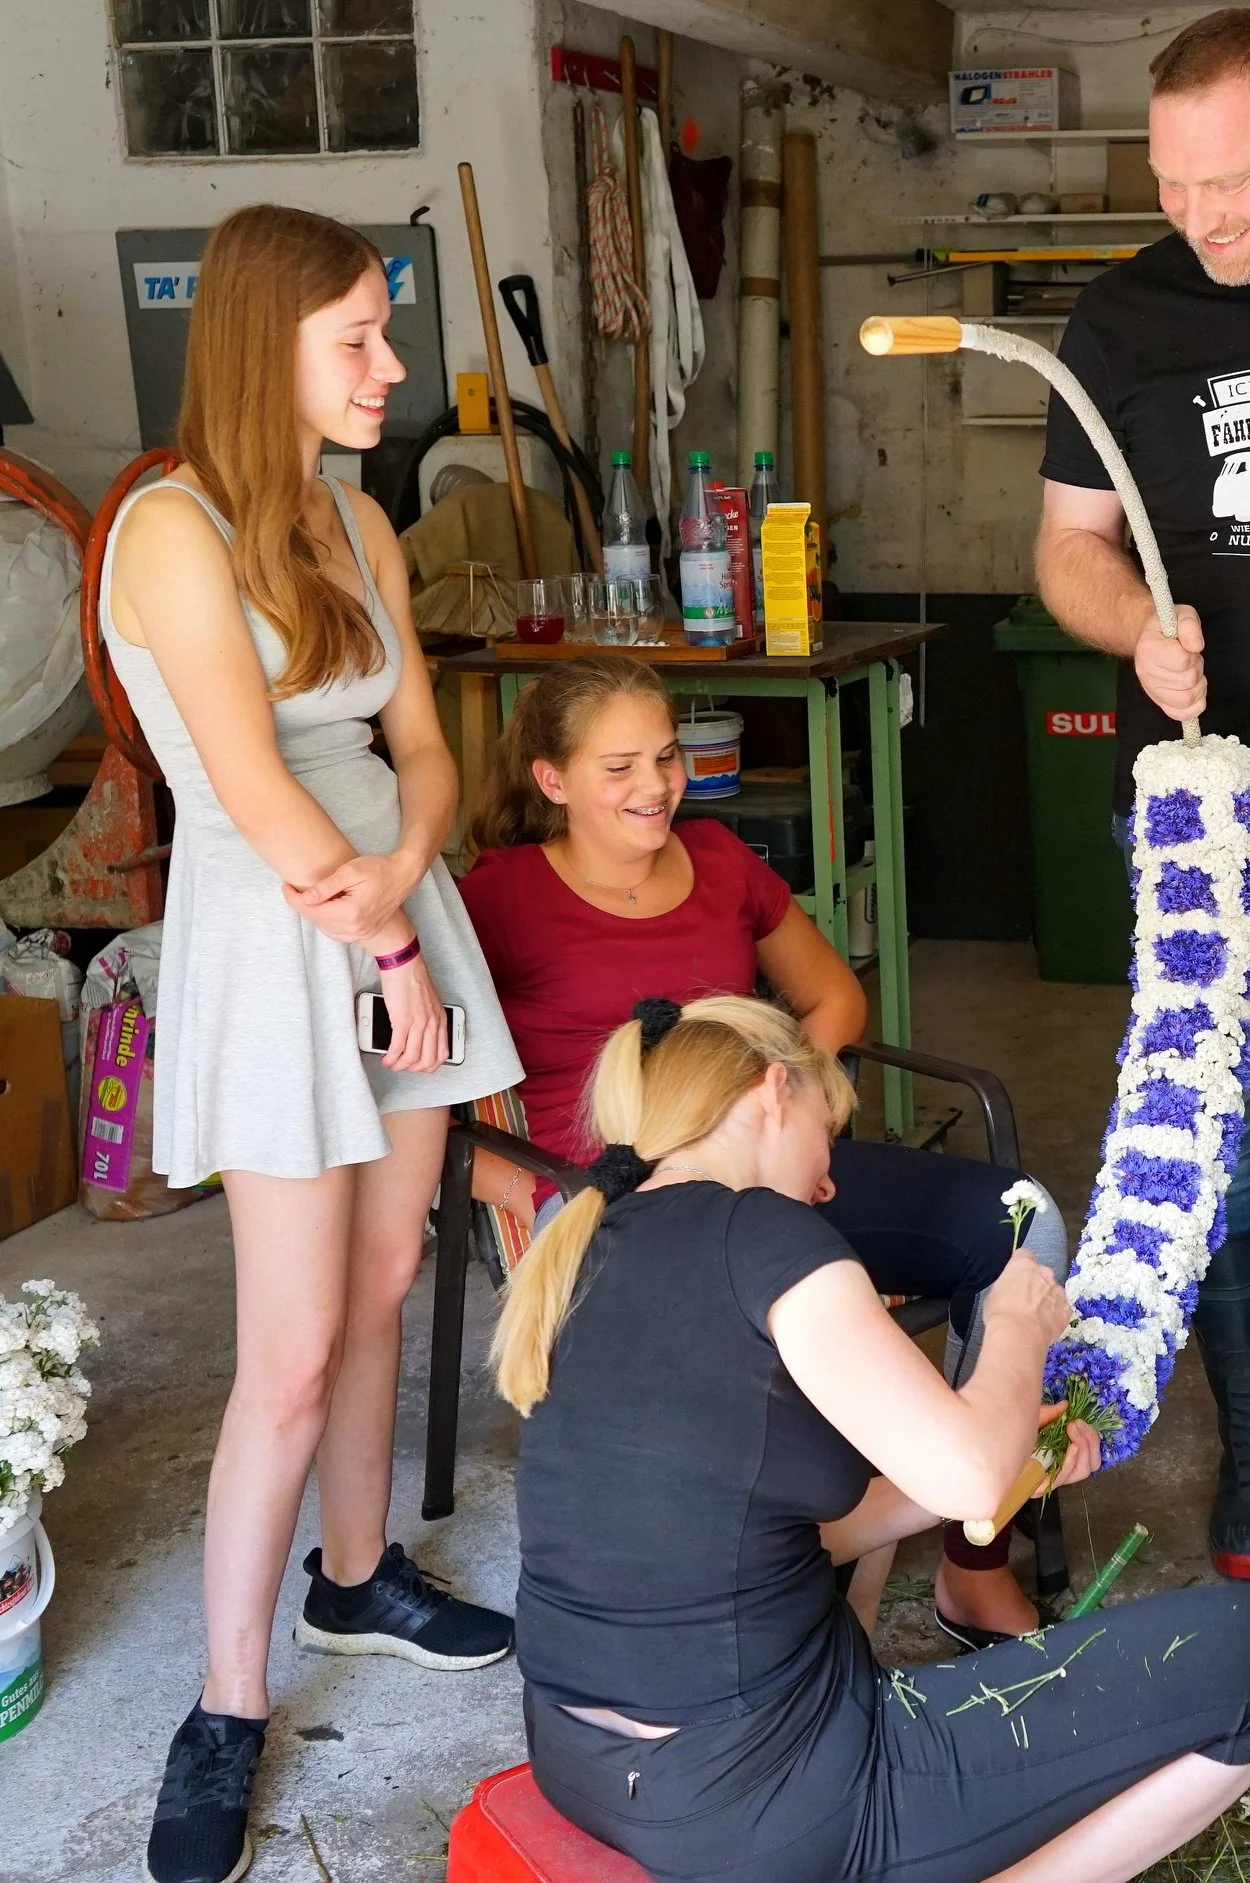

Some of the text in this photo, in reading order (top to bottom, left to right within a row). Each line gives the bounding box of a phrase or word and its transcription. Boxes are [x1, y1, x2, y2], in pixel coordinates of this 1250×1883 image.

[954, 69, 1053, 81] HALOGENSTRAHLER
[1231, 525, 1250, 533] WIE
[93, 1151, 109, 1180] 70L
[1, 1682, 28, 1708] Gutes
